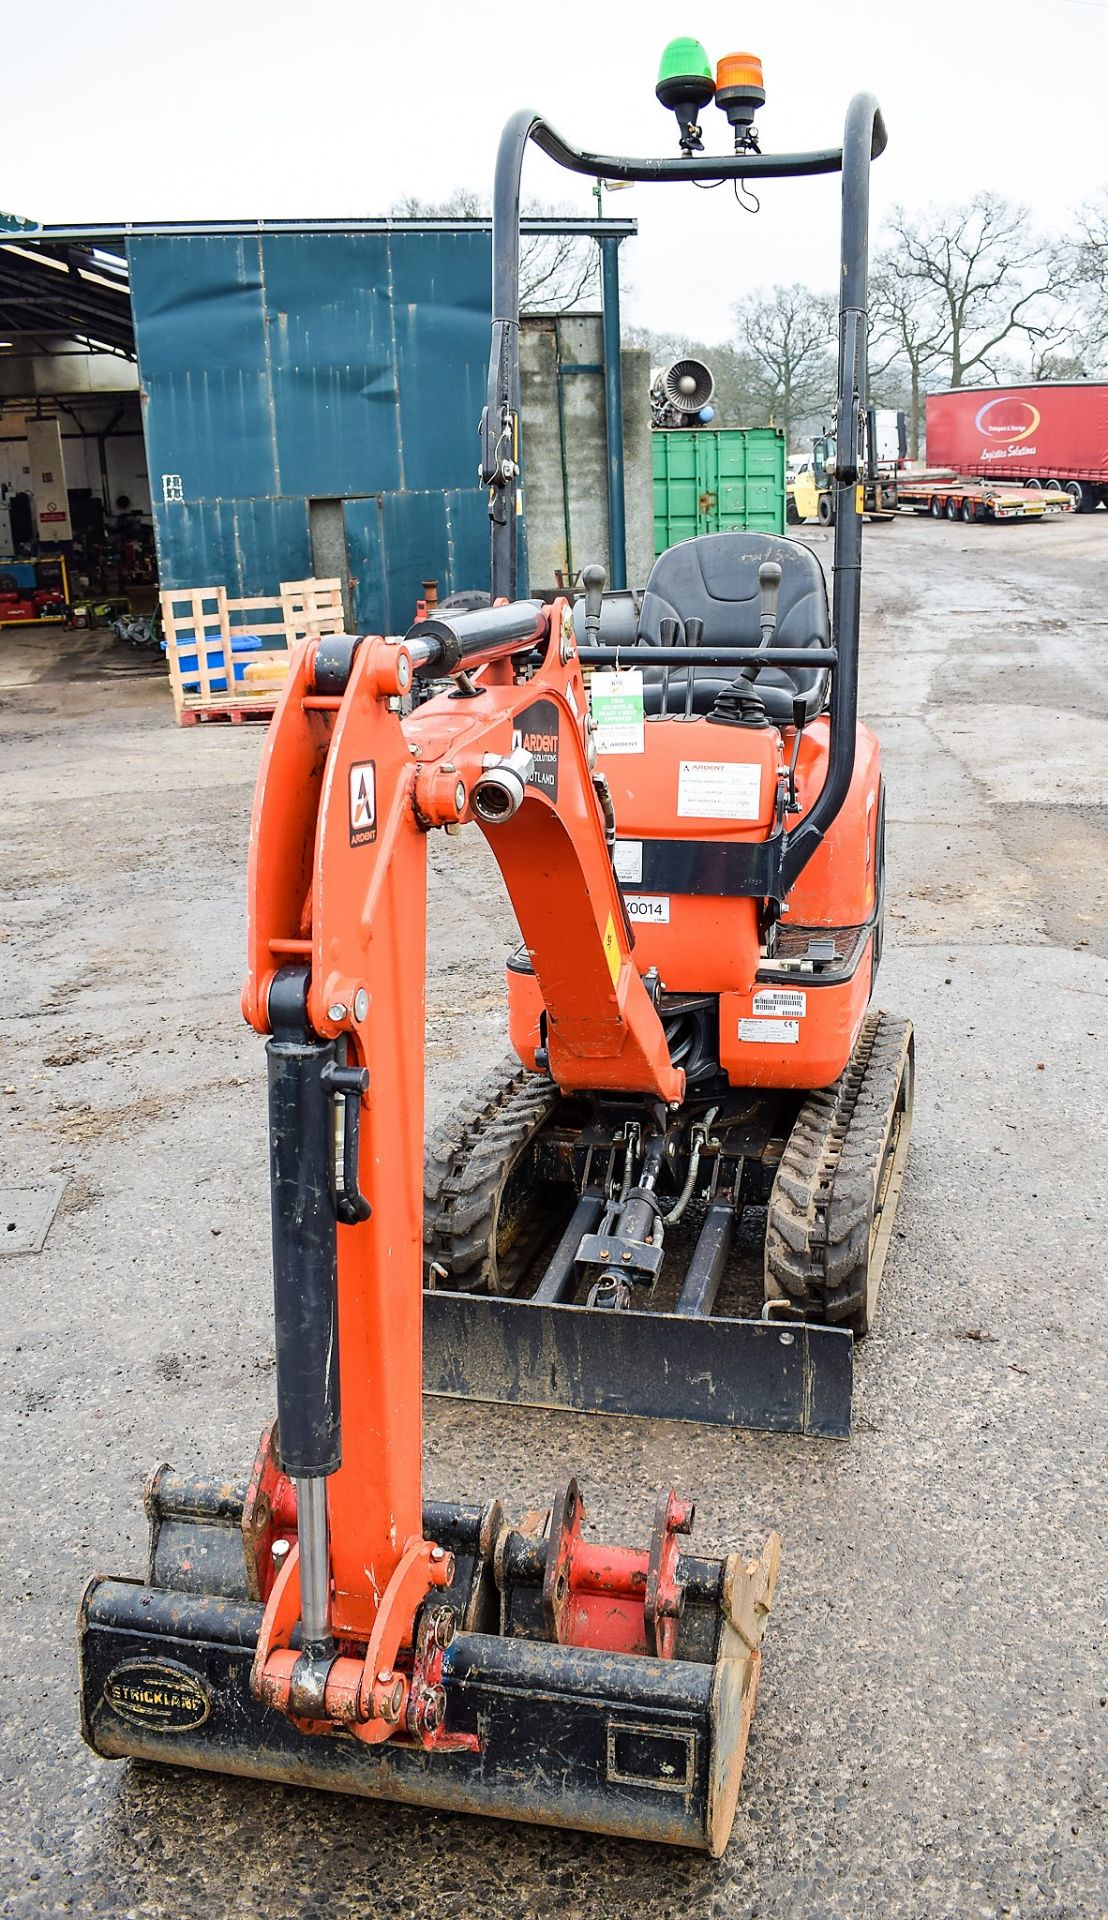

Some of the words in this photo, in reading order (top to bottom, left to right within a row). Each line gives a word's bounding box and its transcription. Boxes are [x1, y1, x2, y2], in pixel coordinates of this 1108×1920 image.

[981, 448, 1007, 462] Logistics
[1008, 444, 1037, 457] Solutions
[523, 733, 558, 753] ARDENT
[609, 741, 638, 749] ARDENT
[533, 754, 557, 762] SOLUTIONS
[691, 764, 725, 772] ARDENT
[529, 771, 555, 785] UTLAND
[351, 830, 376, 845] ARDENT
[111, 1685, 202, 1711] STRICKLAND
